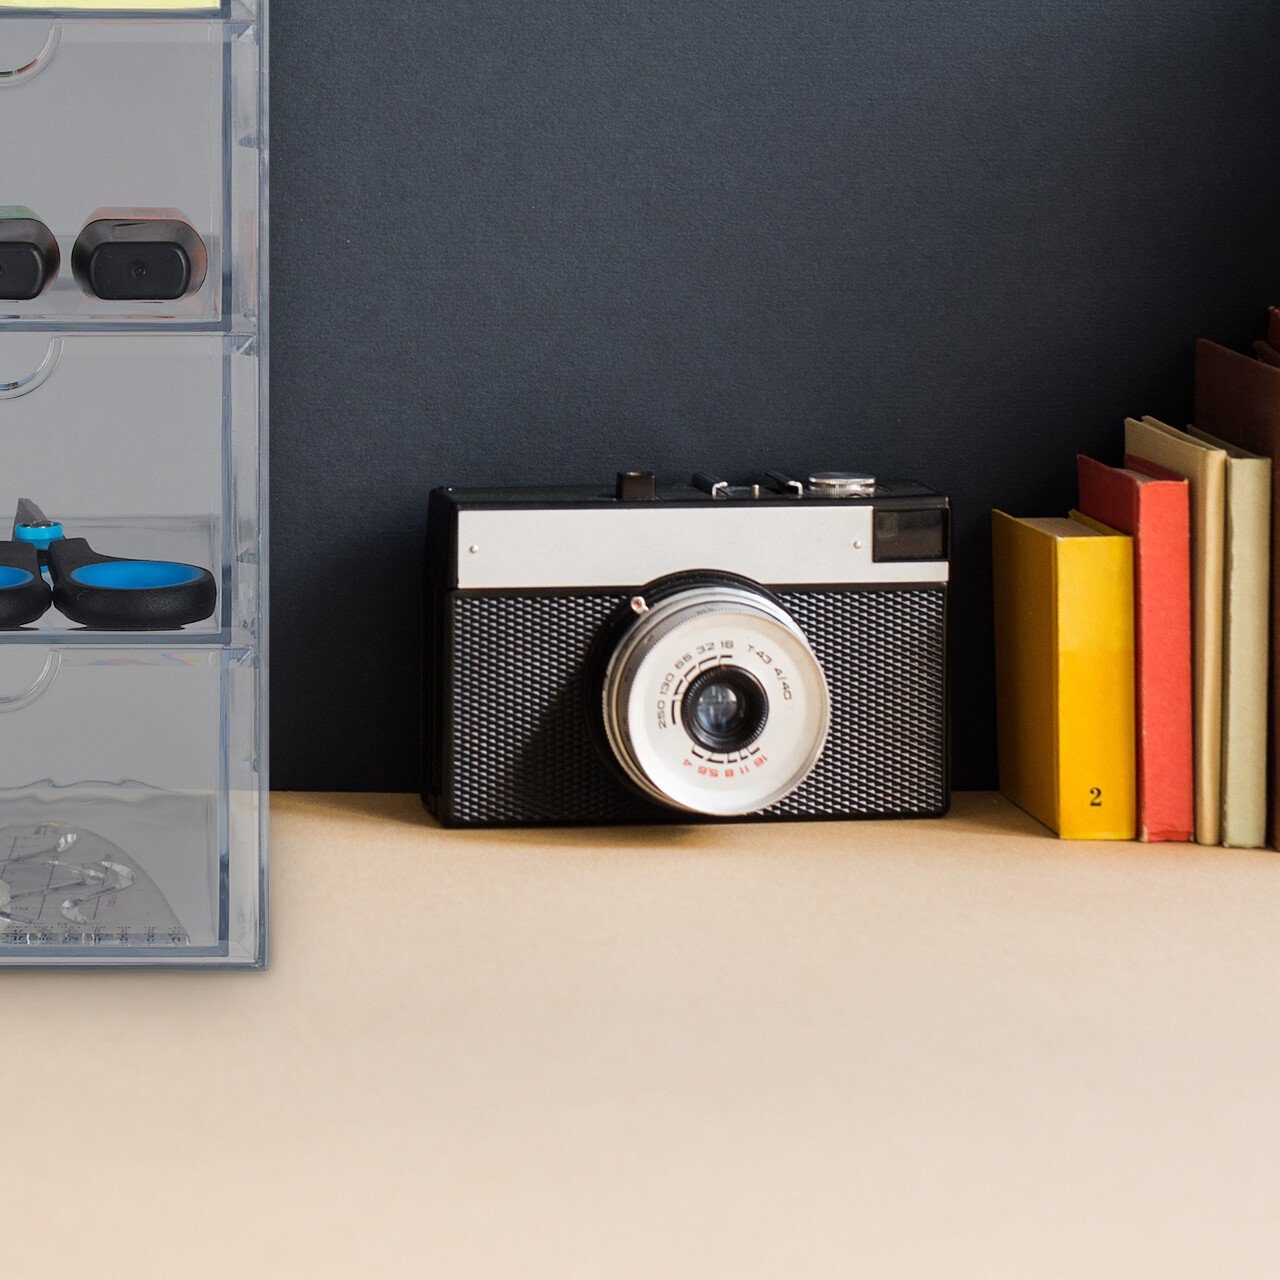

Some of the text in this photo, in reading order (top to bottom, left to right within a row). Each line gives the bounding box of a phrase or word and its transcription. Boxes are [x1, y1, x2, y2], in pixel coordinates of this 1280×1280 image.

[696, 642, 715, 654] 32
[660, 673, 674, 695] 130
[774, 667, 792, 700] 4/40
[657, 700, 666, 729] 250
[1090, 787, 1102, 806] 2
